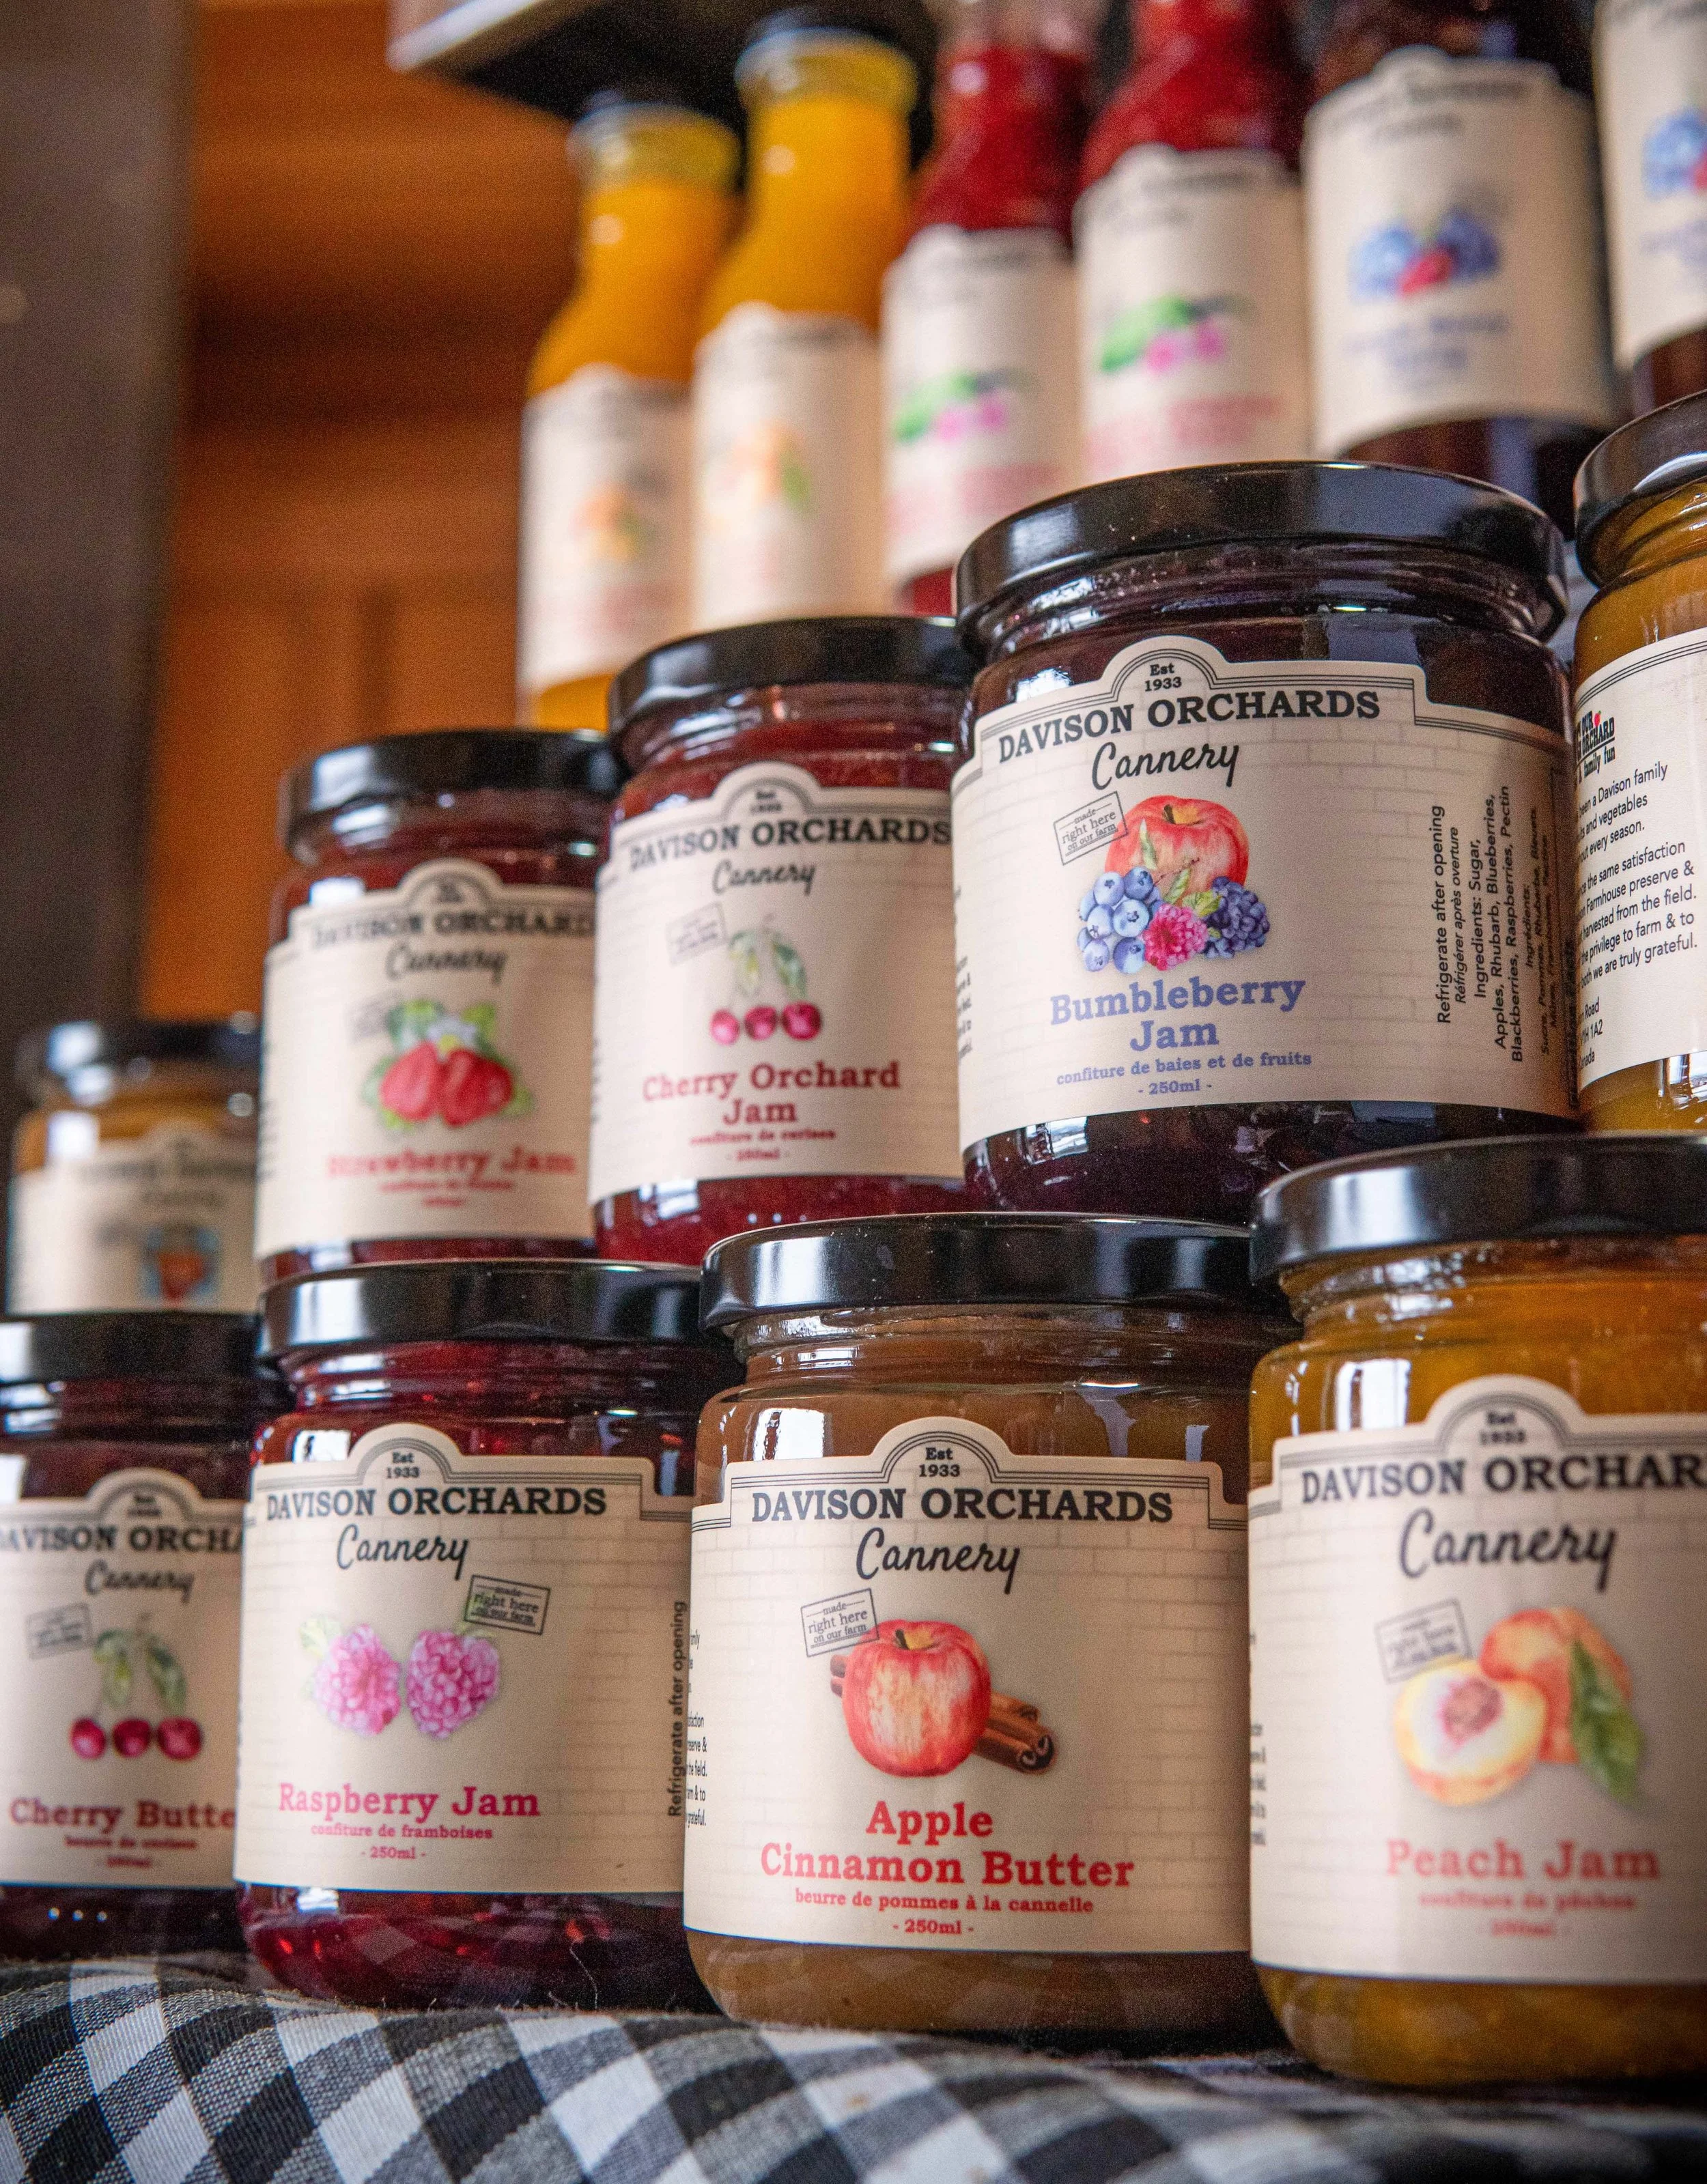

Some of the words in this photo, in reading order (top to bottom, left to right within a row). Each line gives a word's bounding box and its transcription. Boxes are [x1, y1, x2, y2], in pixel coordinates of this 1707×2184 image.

[1144, 676, 1182, 692] 1933
[1149, 662, 1174, 676] Est
[998, 705, 1133, 763] DAVISON
[1148, 690, 1380, 728] ORCHARDS
[1092, 741, 1239, 790] Cannery
[1603, 746, 1616, 765] fun
[1592, 795, 1597, 806] a
[1598, 777, 1631, 804] Davison
[1634, 761, 1668, 785] family
[1062, 823, 1088, 844] right
[1089, 811, 1116, 829] here
[1499, 786, 1512, 838] Pectin
[1586, 812, 1598, 835] and
[1598, 794, 1648, 825] vegetables
[629, 824, 740, 872] DAVISON
[751, 819, 952, 847] ORCHARDS
[1080, 833, 1094, 845] our
[1095, 823, 1116, 838] farm
[1429, 806, 1447, 876] opening
[1483, 794, 1498, 894] Blueberries,
[1590, 834, 1609, 855] every
[1610, 821, 1645, 844] season.
[1450, 826, 1461, 887] overture
[1468, 838, 1484, 892] Sugar,
[1598, 863, 1620, 882] same
[1622, 842, 1686, 872] satisfaction
[712, 860, 815, 896] Cannery
[1502, 844, 1518, 947] Raspberries,
[1586, 885, 1626, 914] Farmhouse
[1629, 867, 1678, 897] preserve
[1683, 860, 1695, 876] &
[1431, 881, 1447, 922] after
[1450, 890, 1466, 930] après
[1616, 902, 1639, 922] from
[1641, 894, 1661, 913] the
[1664, 883, 1697, 906] field.
[1471, 896, 1489, 998] Ingredients:
[1487, 901, 1503, 977] Rhubarb,
[1590, 935, 1621, 963] privilege
[1622, 928, 1633, 943] to
[1636, 920, 1661, 938] farm
[1665, 913, 1676, 928] &
[1680, 913, 1695, 925] to
[1592, 965, 1603, 980] we
[1605, 959, 1618, 974] are
[1620, 946, 1641, 968] truly
[1644, 932, 1697, 964] grateful.
[1435, 928, 1452, 1024] Refrigerate
[1453, 933, 1468, 1004] Réfrigérer
[1050, 976, 1306, 1027] Bumbleberry
[1491, 984, 1508, 1050] Apples,
[1507, 954, 1523, 1062] Blackberries,
[1585, 996, 1600, 1020] Road
[1129, 1021, 1219, 1052] Jam
[1590, 1019, 1604, 1039] 1A2
[642, 1070, 737, 1102] Cherry
[750, 1061, 901, 1092] Orchard
[1056, 1063, 1125, 1086] confiture
[1130, 1060, 1151, 1076] de
[1155, 1056, 1202, 1073] baies
[1207, 1055, 1227, 1068] et
[1232, 1053, 1254, 1068] de
[1260, 1051, 1312, 1066] fruits
[722, 1100, 798, 1125] Jam
[385, 1466, 420, 1480] 1933
[392, 1451, 414, 1465] Est
[918, 1463, 961, 1478] 1933
[925, 1447, 955, 1462] Est
[1301, 1460, 1466, 1505] DAVISON
[1484, 1454, 1707, 1492] ORCHAR
[266, 1488, 376, 1521] DAVISON
[387, 1487, 606, 1516] ORCHARDS
[752, 1489, 905, 1523] DAVISON
[920, 1488, 1173, 1524] ORCHARDS
[337, 1523, 470, 1580] Cannery
[856, 1527, 1023, 1595] Cannery
[1400, 1507, 1620, 1594] Cannery
[474, 1592, 505, 1610] right
[509, 1597, 539, 1613] here
[808, 1617, 837, 1635] right
[838, 1610, 868, 1626] here
[822, 1601, 847, 1615] made
[671, 1600, 687, 1671] opening
[813, 1634, 825, 1644] on
[826, 1628, 842, 1640] our
[844, 1623, 866, 1636] farm
[668, 1677, 684, 1716] after
[668, 1721, 686, 1817] Refrigerate
[10, 1797, 122, 1834] Cherry
[278, 1783, 438, 1824] Raspberry
[451, 1786, 541, 1818] Jam
[865, 1800, 993, 1845] Apple
[311, 1822, 373, 1838] confiture
[378, 1824, 396, 1839] de
[401, 1824, 493, 1840] framboises
[761, 1843, 965, 1885] Cinnamon
[982, 1850, 1135, 1889] Butter
[1386, 1839, 1524, 1879] Peach
[1543, 1841, 1660, 1880] Jam
[795, 1888, 847, 1907] beurre
[851, 1890, 873, 1908] de
[878, 1895, 960, 1912] pommes
[965, 1893, 977, 1911] à
[984, 1894, 1002, 1912] la
[1008, 1897, 1094, 1914] cannelle
